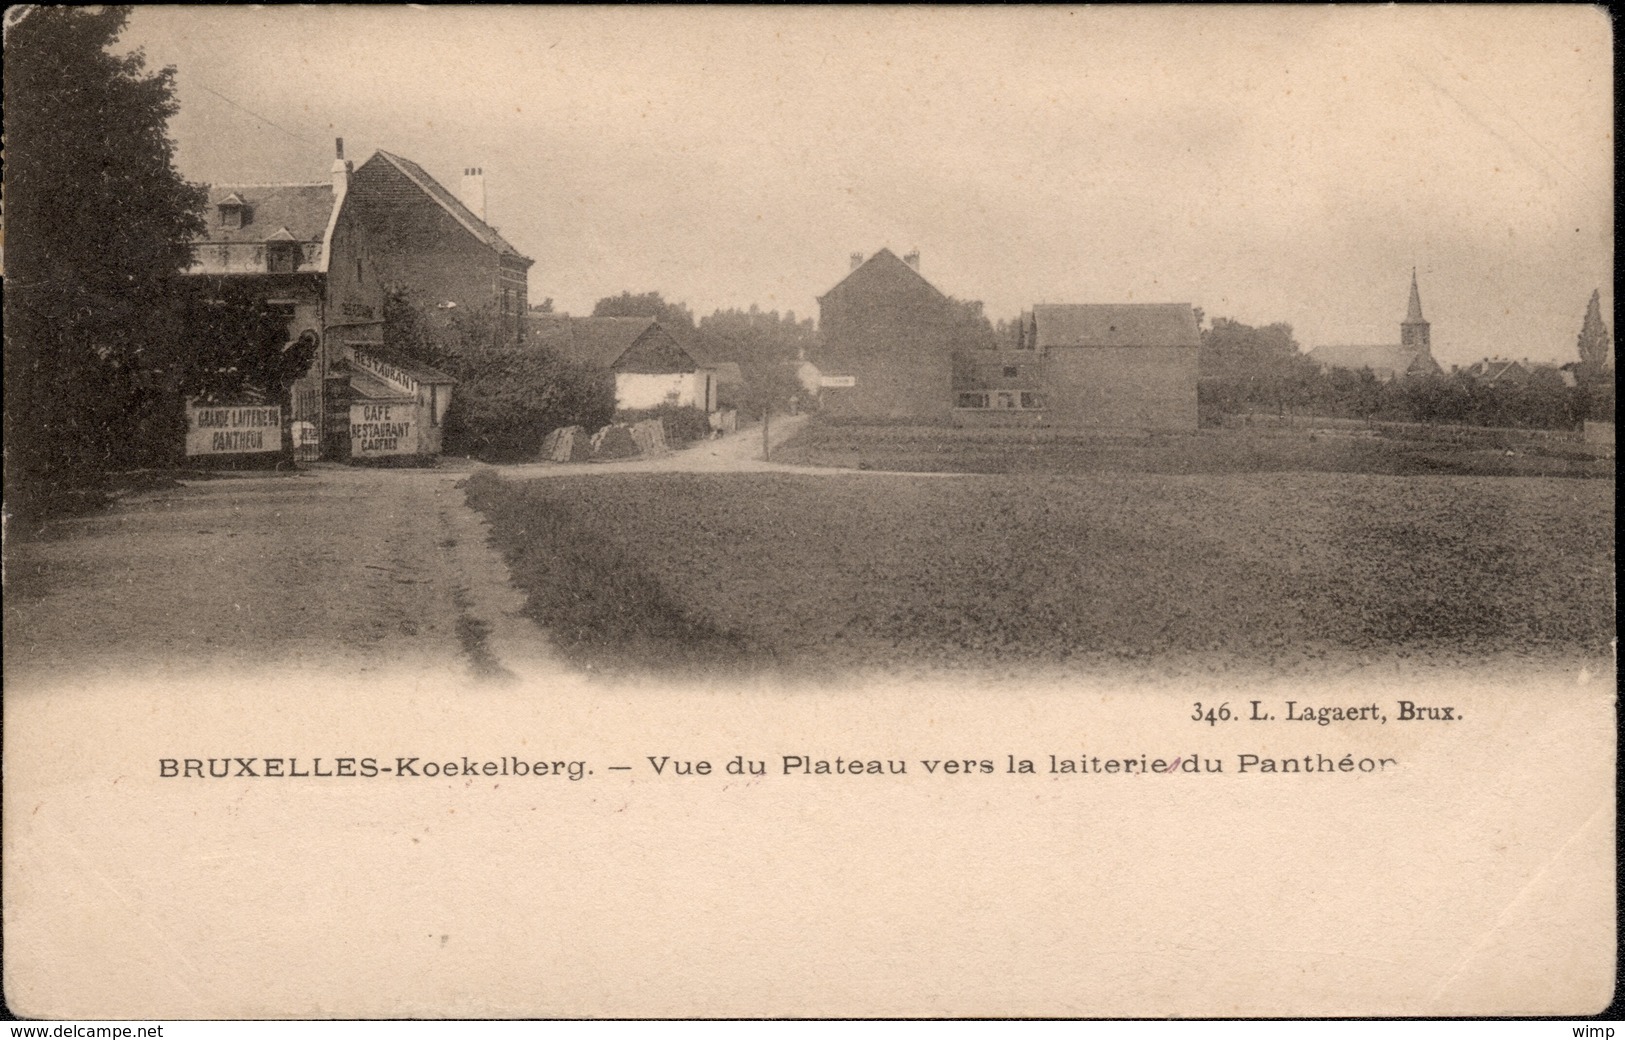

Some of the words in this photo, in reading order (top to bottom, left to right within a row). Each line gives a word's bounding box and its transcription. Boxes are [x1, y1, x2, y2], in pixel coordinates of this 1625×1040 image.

[354, 349, 414, 392] RESTAURANT
[212, 430, 263, 451] PANTHEON
[351, 422, 410, 439] RESTAURANT
